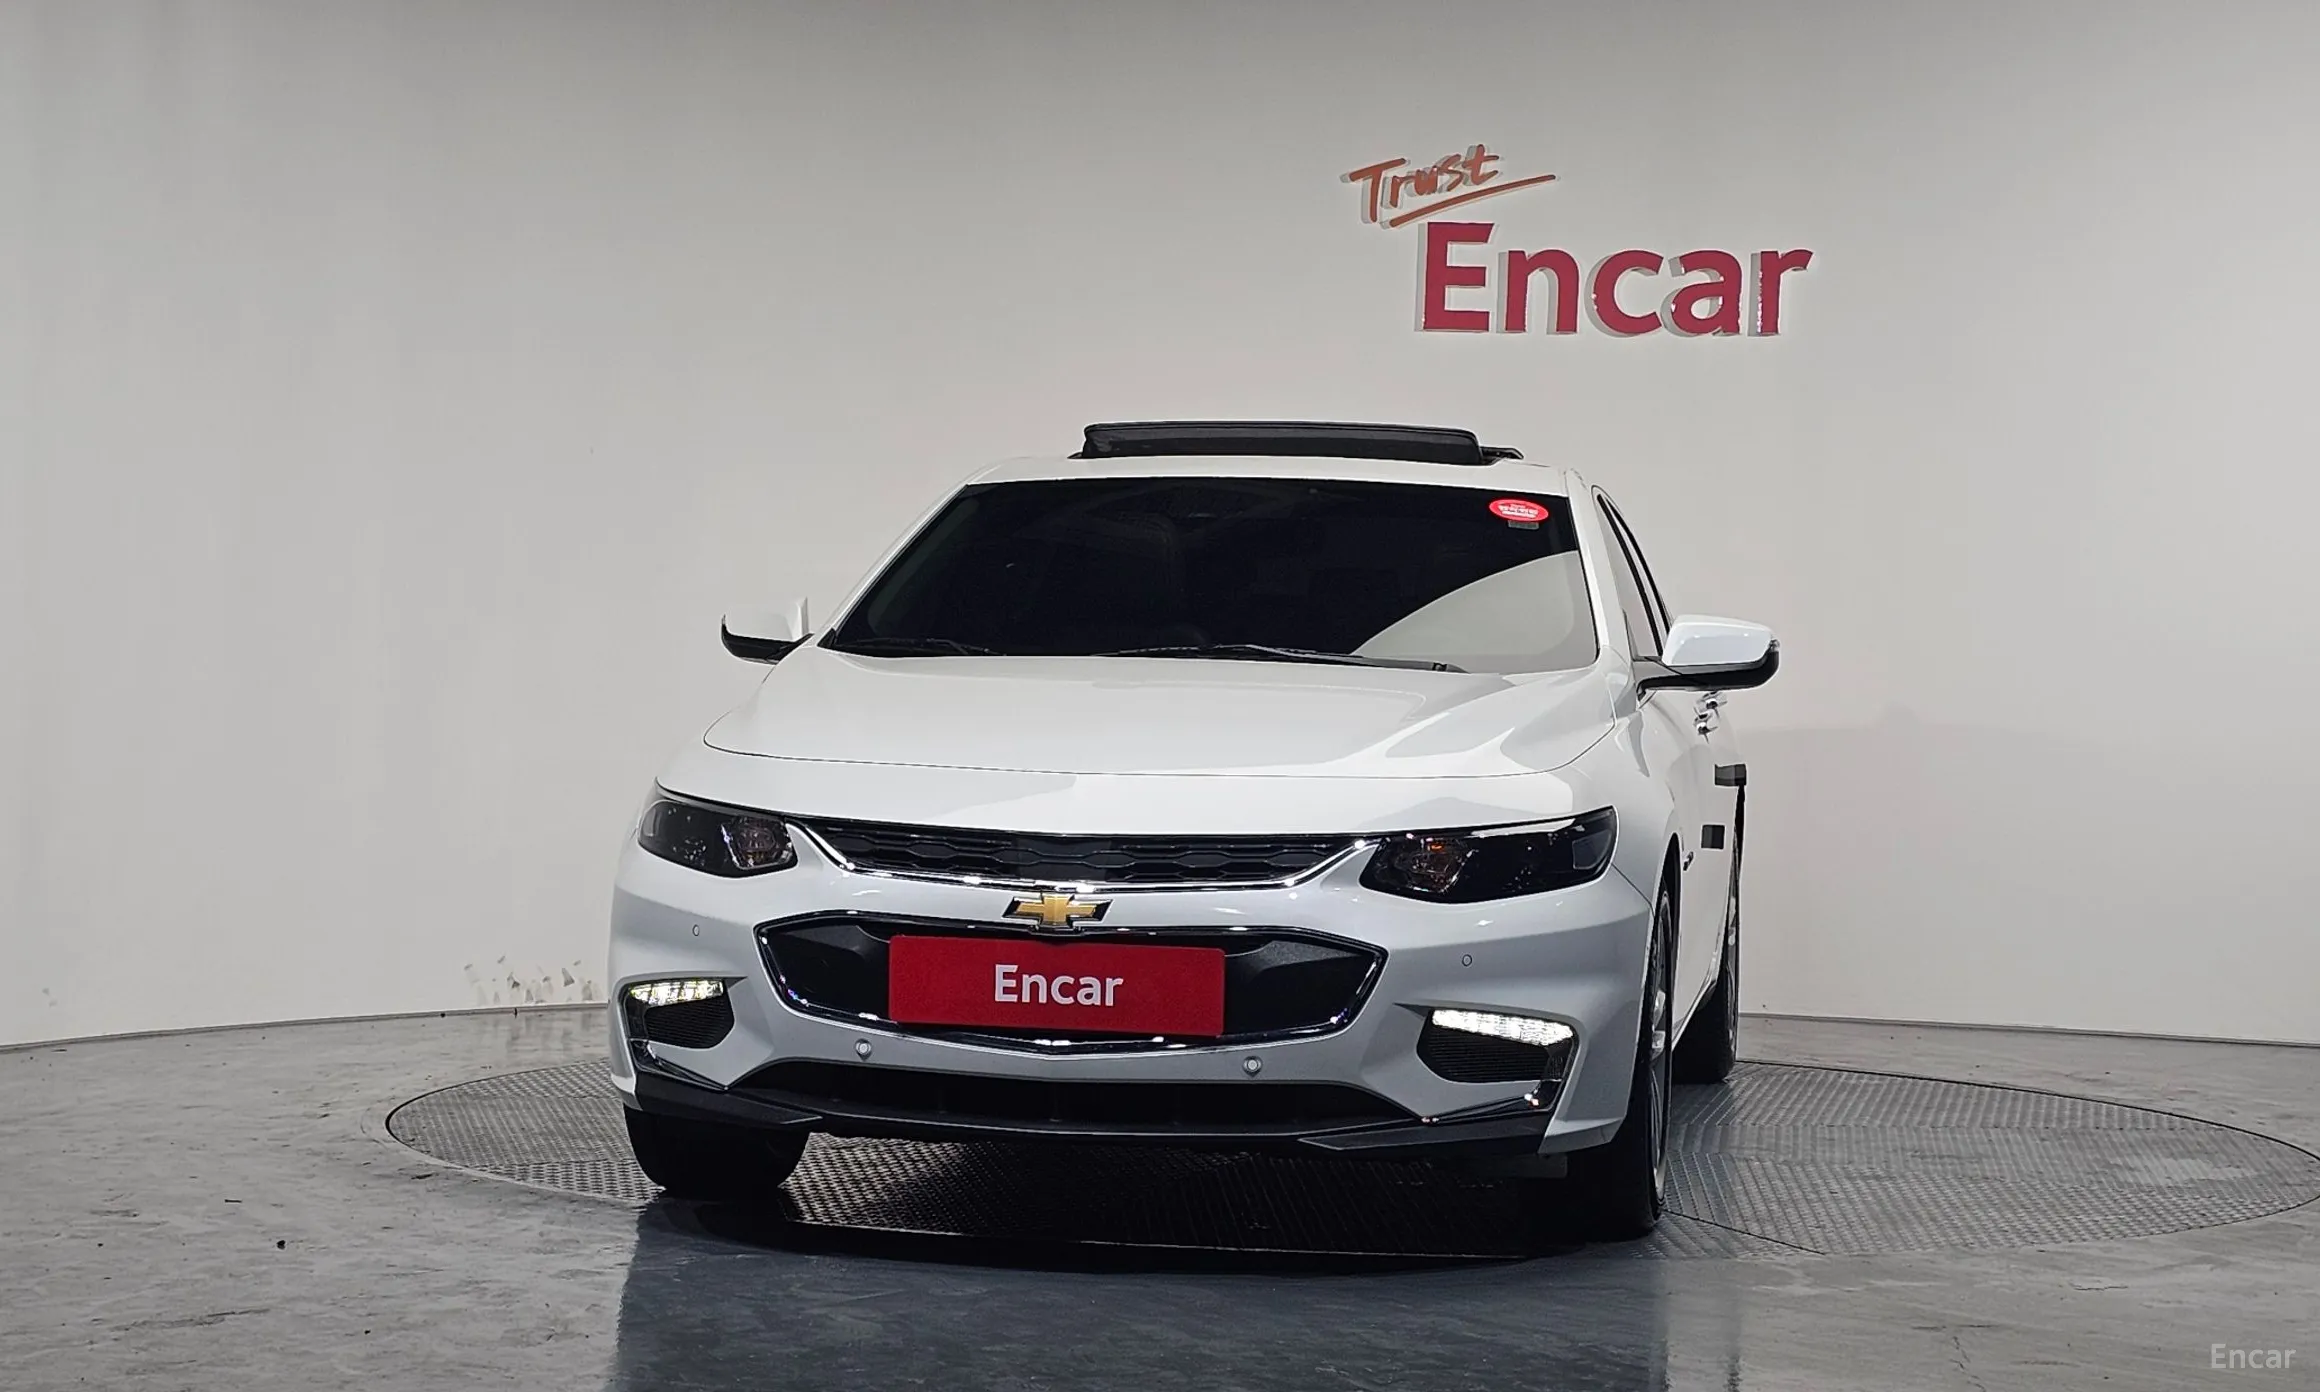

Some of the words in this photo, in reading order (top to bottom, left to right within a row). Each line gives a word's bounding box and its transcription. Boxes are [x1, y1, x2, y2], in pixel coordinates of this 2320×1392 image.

[1348, 143, 1500, 223] Trust
[1420, 221, 1814, 336] Encar
[994, 963, 1124, 1007] Encar
